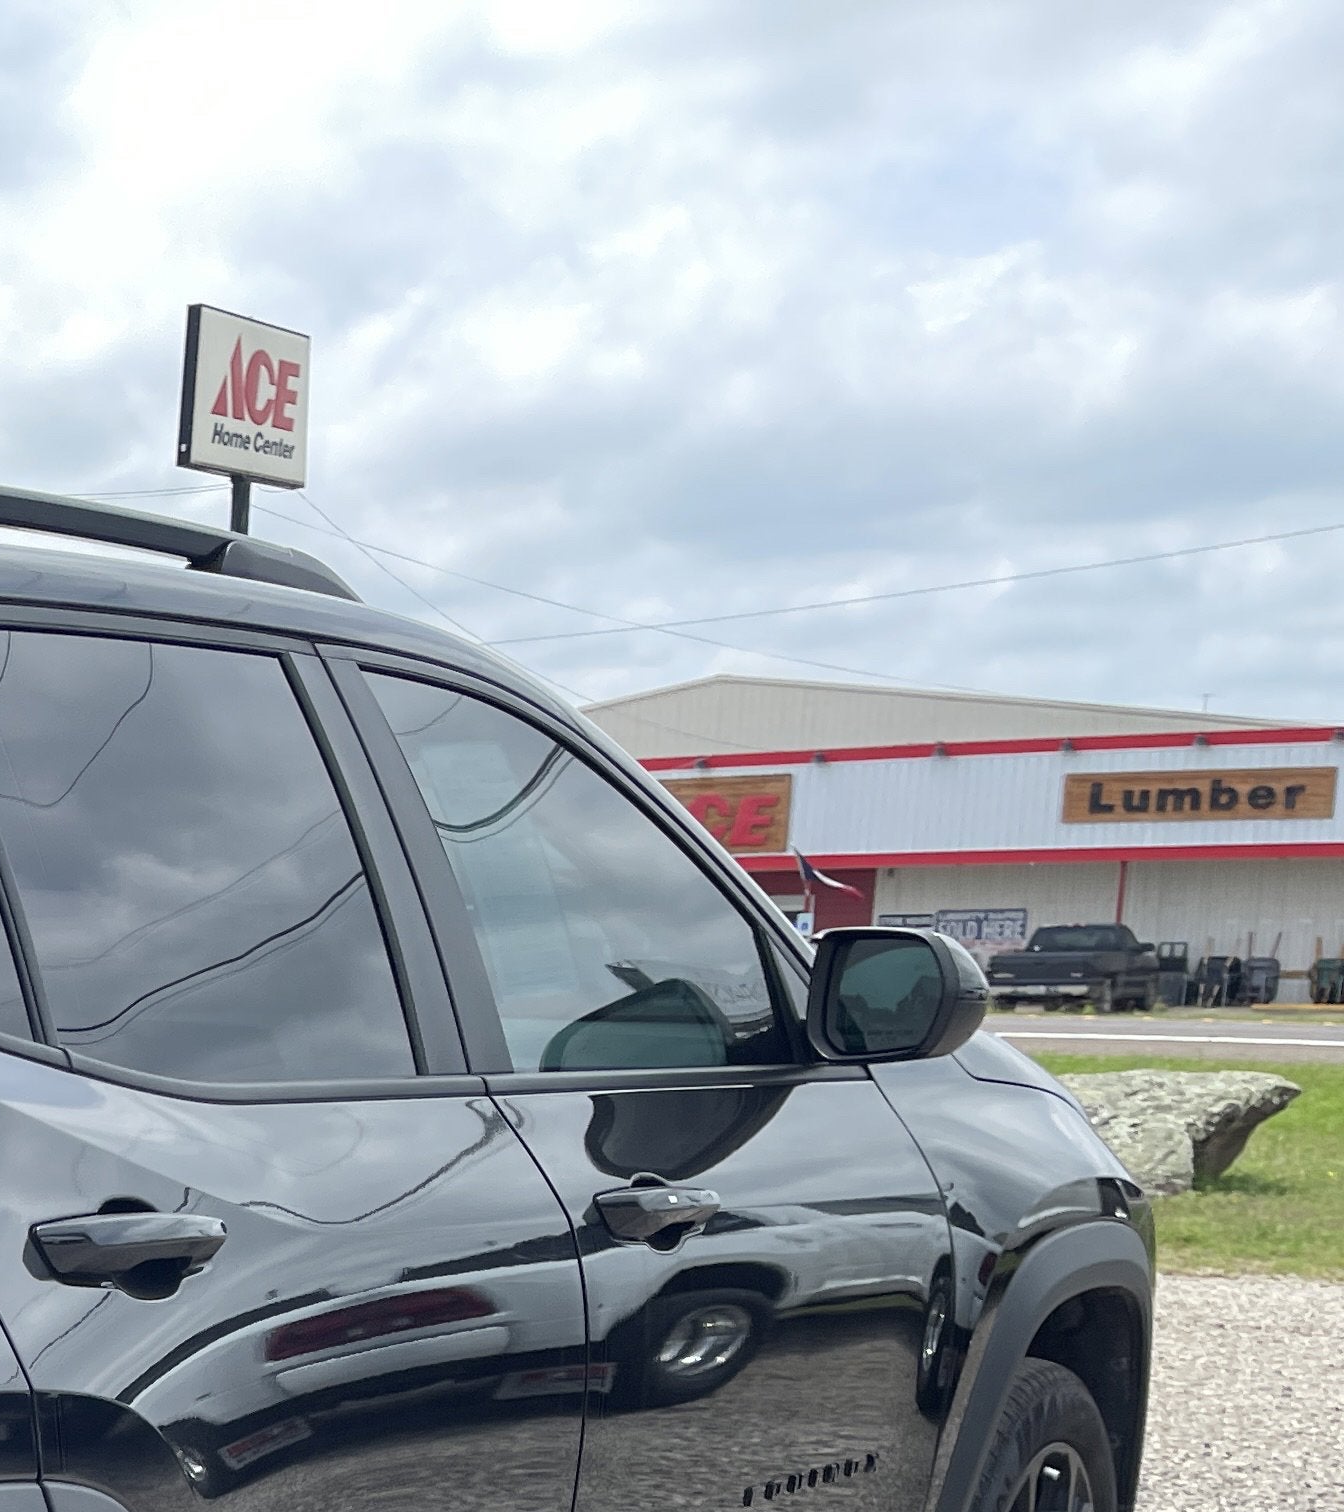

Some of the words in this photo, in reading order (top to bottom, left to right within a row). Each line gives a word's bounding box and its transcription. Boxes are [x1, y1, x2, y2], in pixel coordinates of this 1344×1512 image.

[211, 334, 301, 431] ACE
[212, 422, 250, 450] Home
[253, 431, 295, 459] Center
[688, 792, 780, 846] CE
[1088, 779, 1306, 814] Lumber
